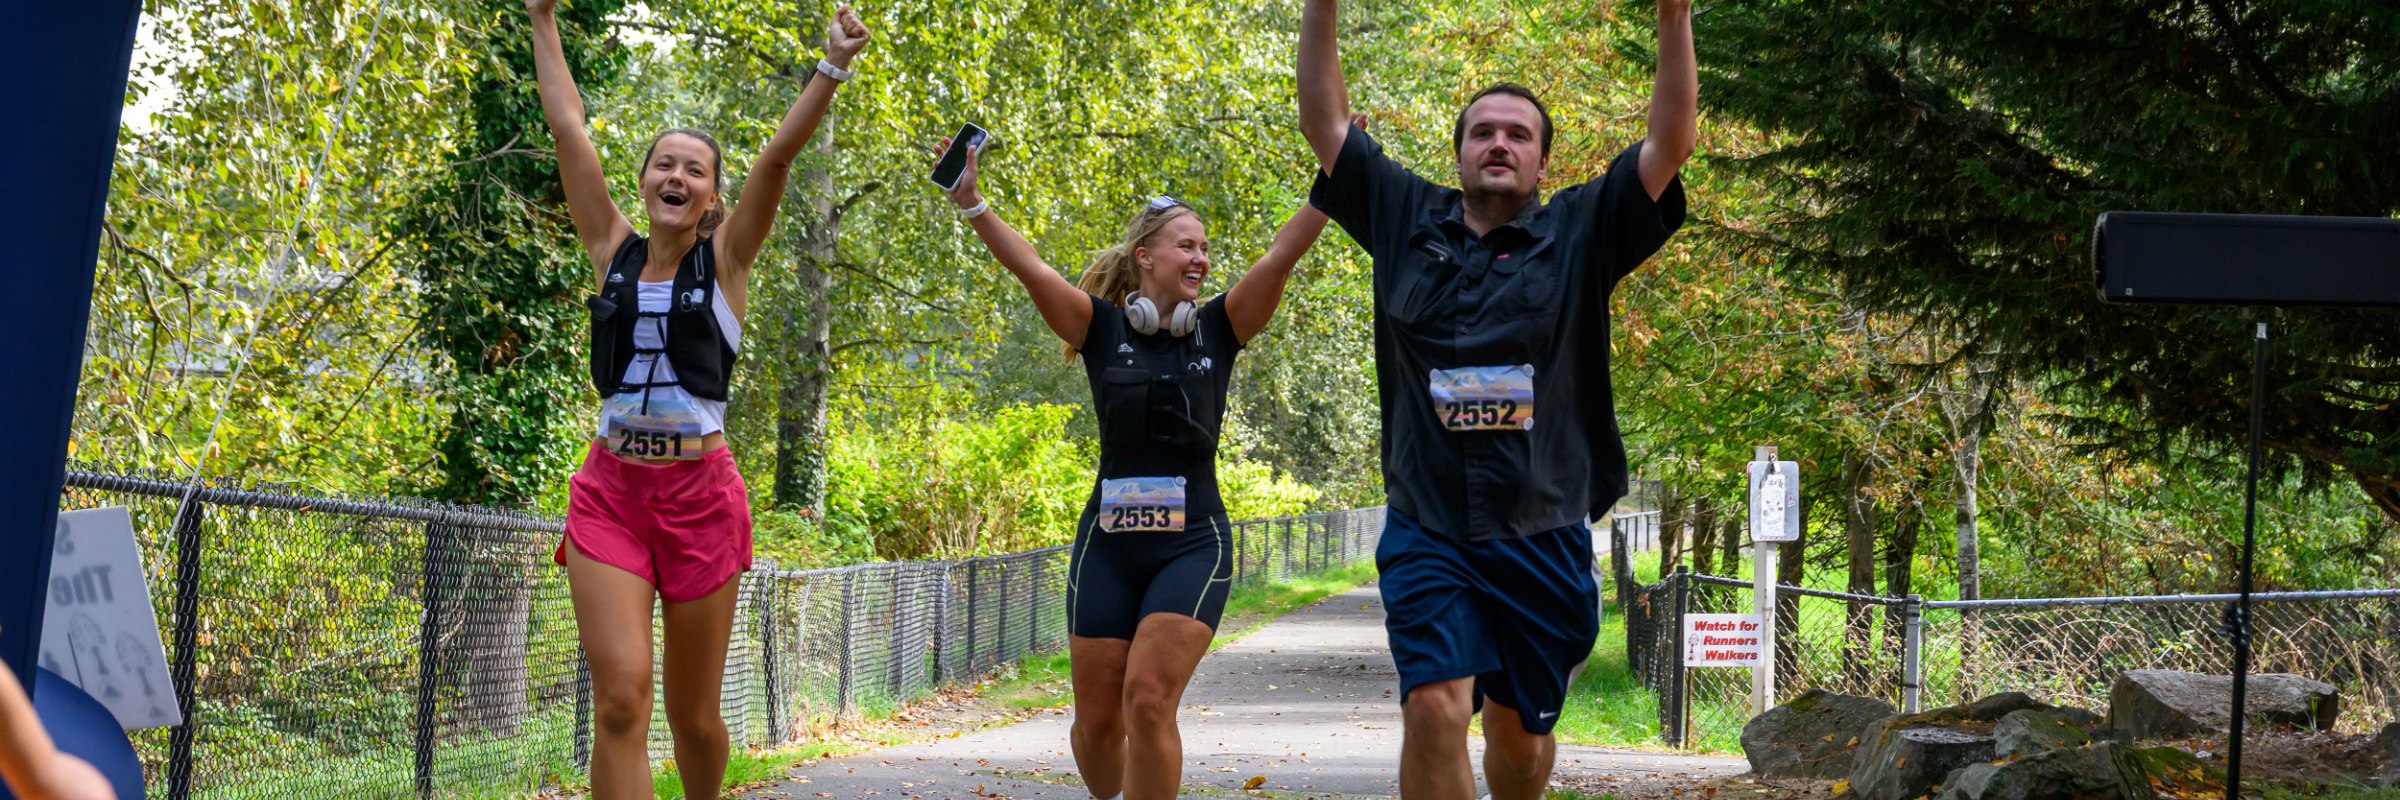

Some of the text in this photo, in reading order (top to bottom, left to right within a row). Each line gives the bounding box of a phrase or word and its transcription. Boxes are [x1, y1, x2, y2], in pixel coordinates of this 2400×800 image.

[1445, 400, 1517, 427] 2552
[620, 428, 682, 457] 2551
[1112, 506, 1171, 529] 2553
[1694, 620, 1759, 632] Watch for
[1703, 635, 1758, 646] Runners
[1705, 649, 1758, 661] Walkers
